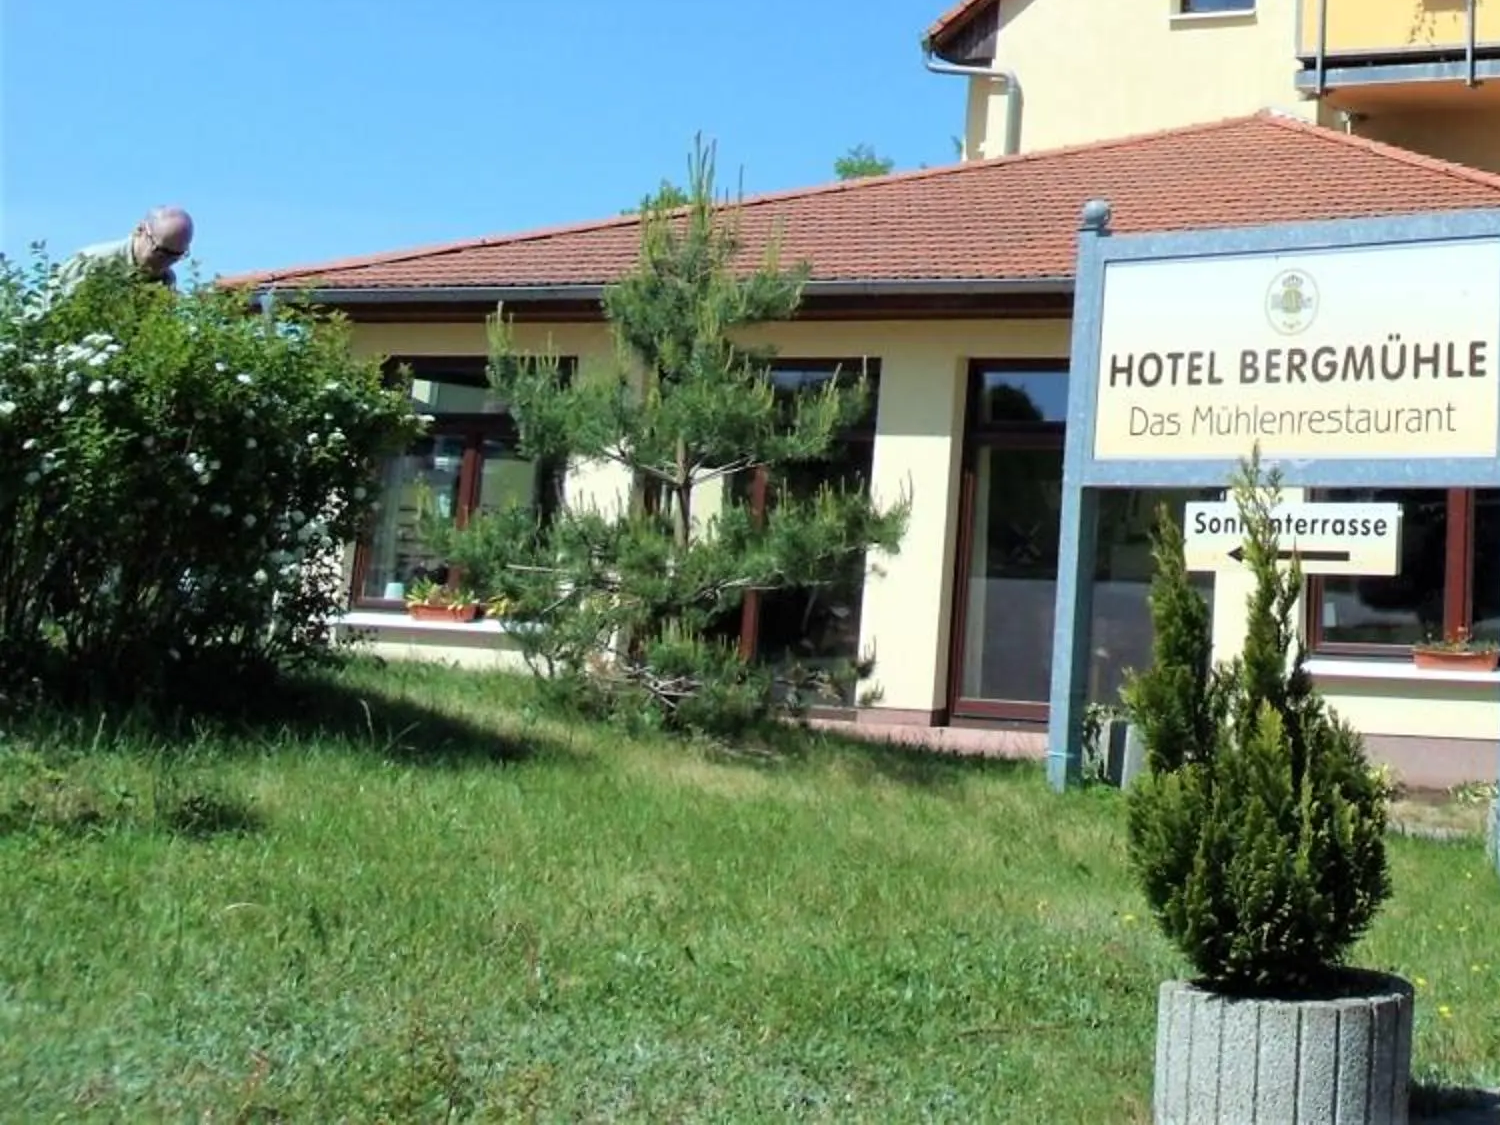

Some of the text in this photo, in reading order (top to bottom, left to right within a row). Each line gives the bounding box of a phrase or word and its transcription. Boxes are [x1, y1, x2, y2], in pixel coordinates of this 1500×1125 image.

[1109, 334, 1488, 388] HOTEL BERGMÜHLE
[1129, 401, 1457, 437] Das Mühlenrestaurant
[1194, 512, 1388, 537] Sonnterrasse
